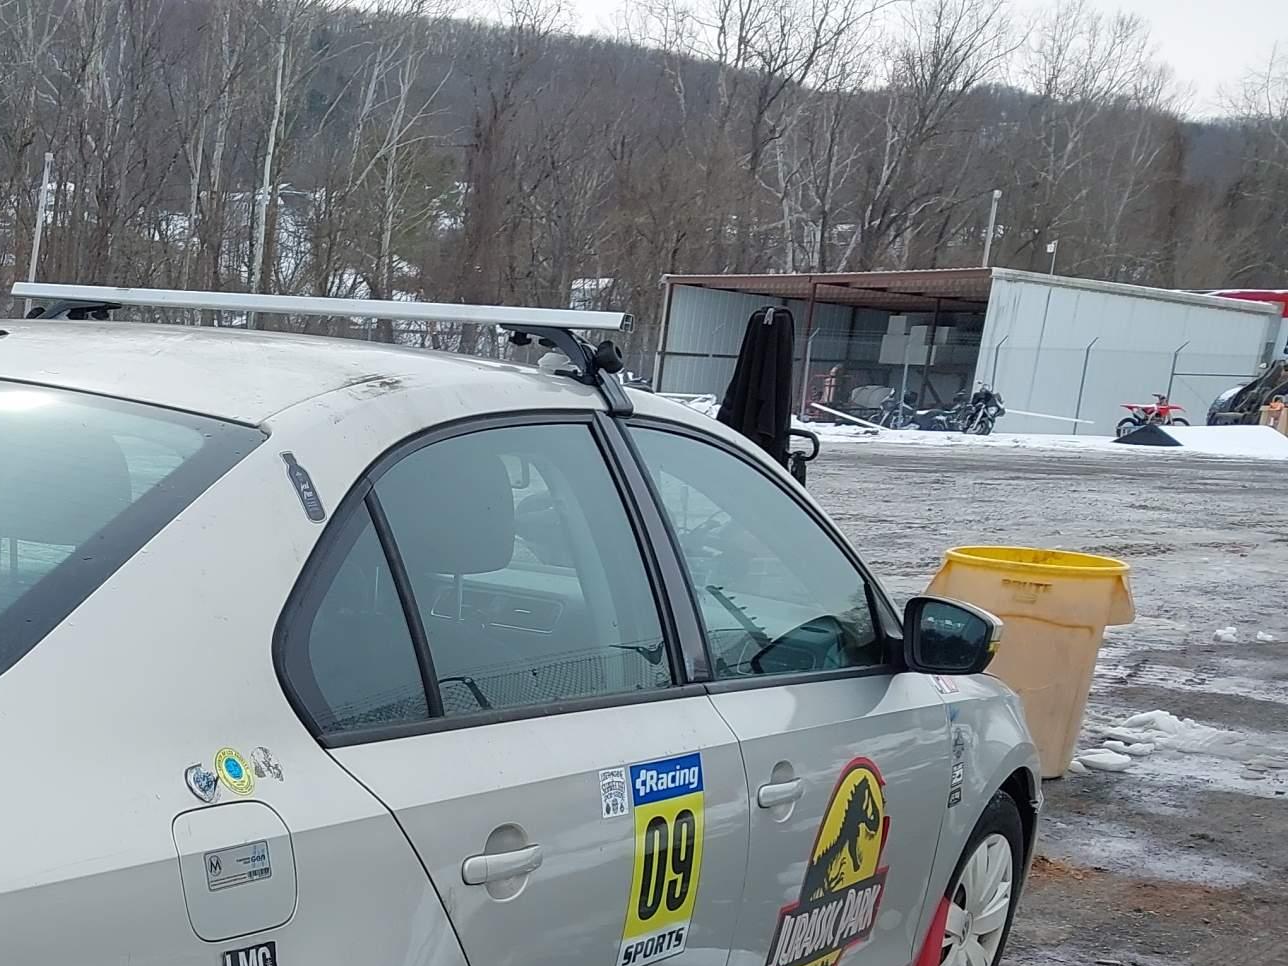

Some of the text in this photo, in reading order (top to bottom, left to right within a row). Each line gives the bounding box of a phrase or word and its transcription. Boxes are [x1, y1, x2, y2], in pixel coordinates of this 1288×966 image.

[637, 808, 696, 921] 09
[621, 927, 685, 966] SPORTS
[832, 884, 882, 949] PARK
